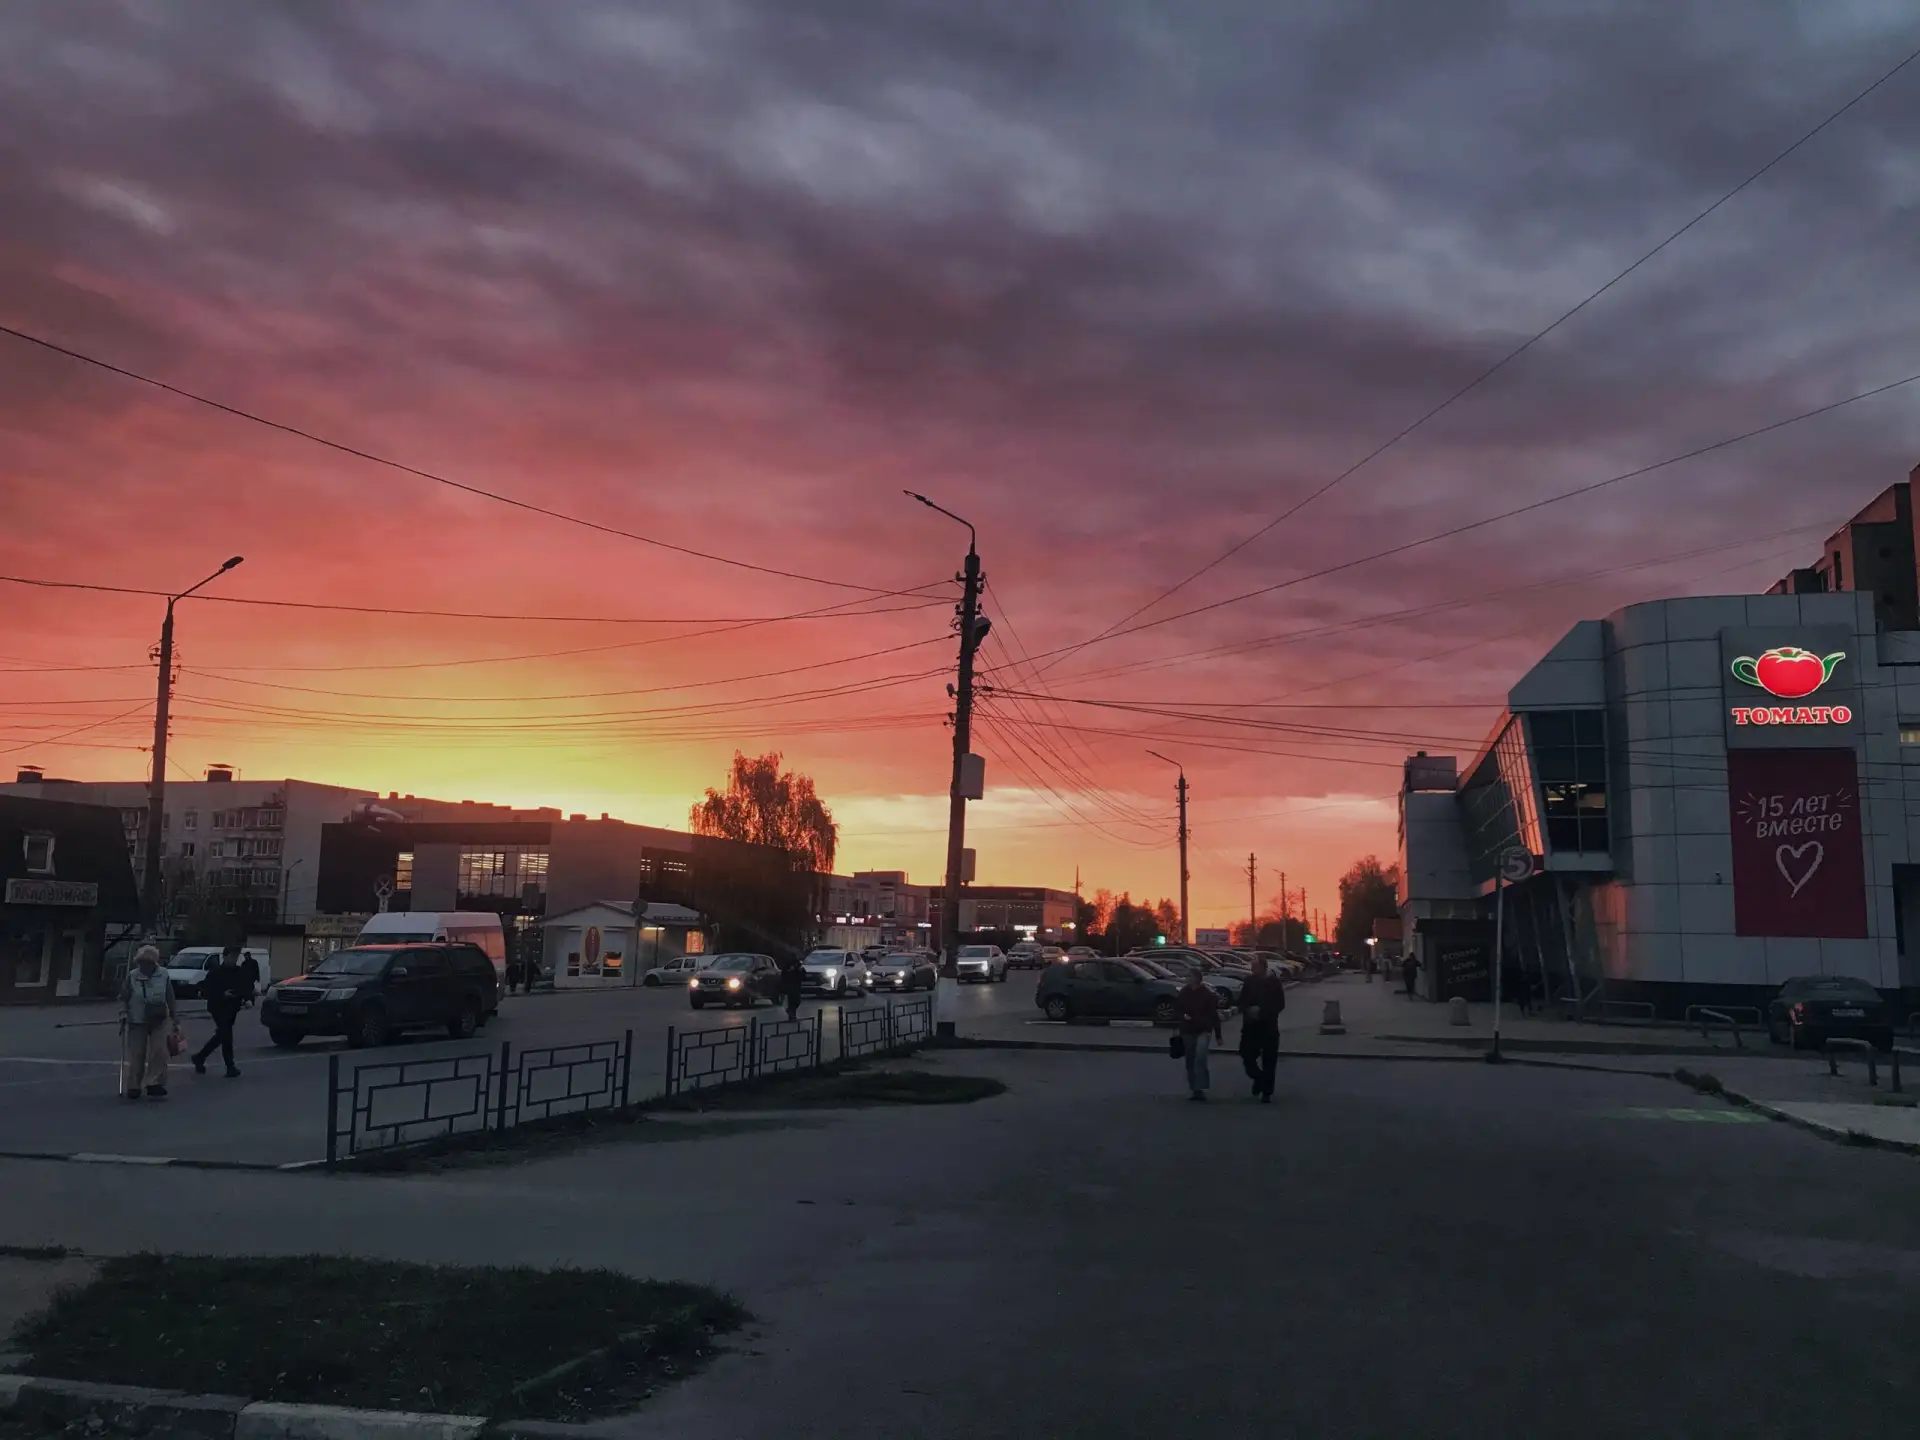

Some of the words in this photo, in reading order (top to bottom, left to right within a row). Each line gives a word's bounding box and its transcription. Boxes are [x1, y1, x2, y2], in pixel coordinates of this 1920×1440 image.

[1731, 706, 1852, 725] TOMATO
[1758, 795, 1784, 818] 15
[1790, 795, 1830, 814] лет
[1756, 813, 1842, 839] вместе
